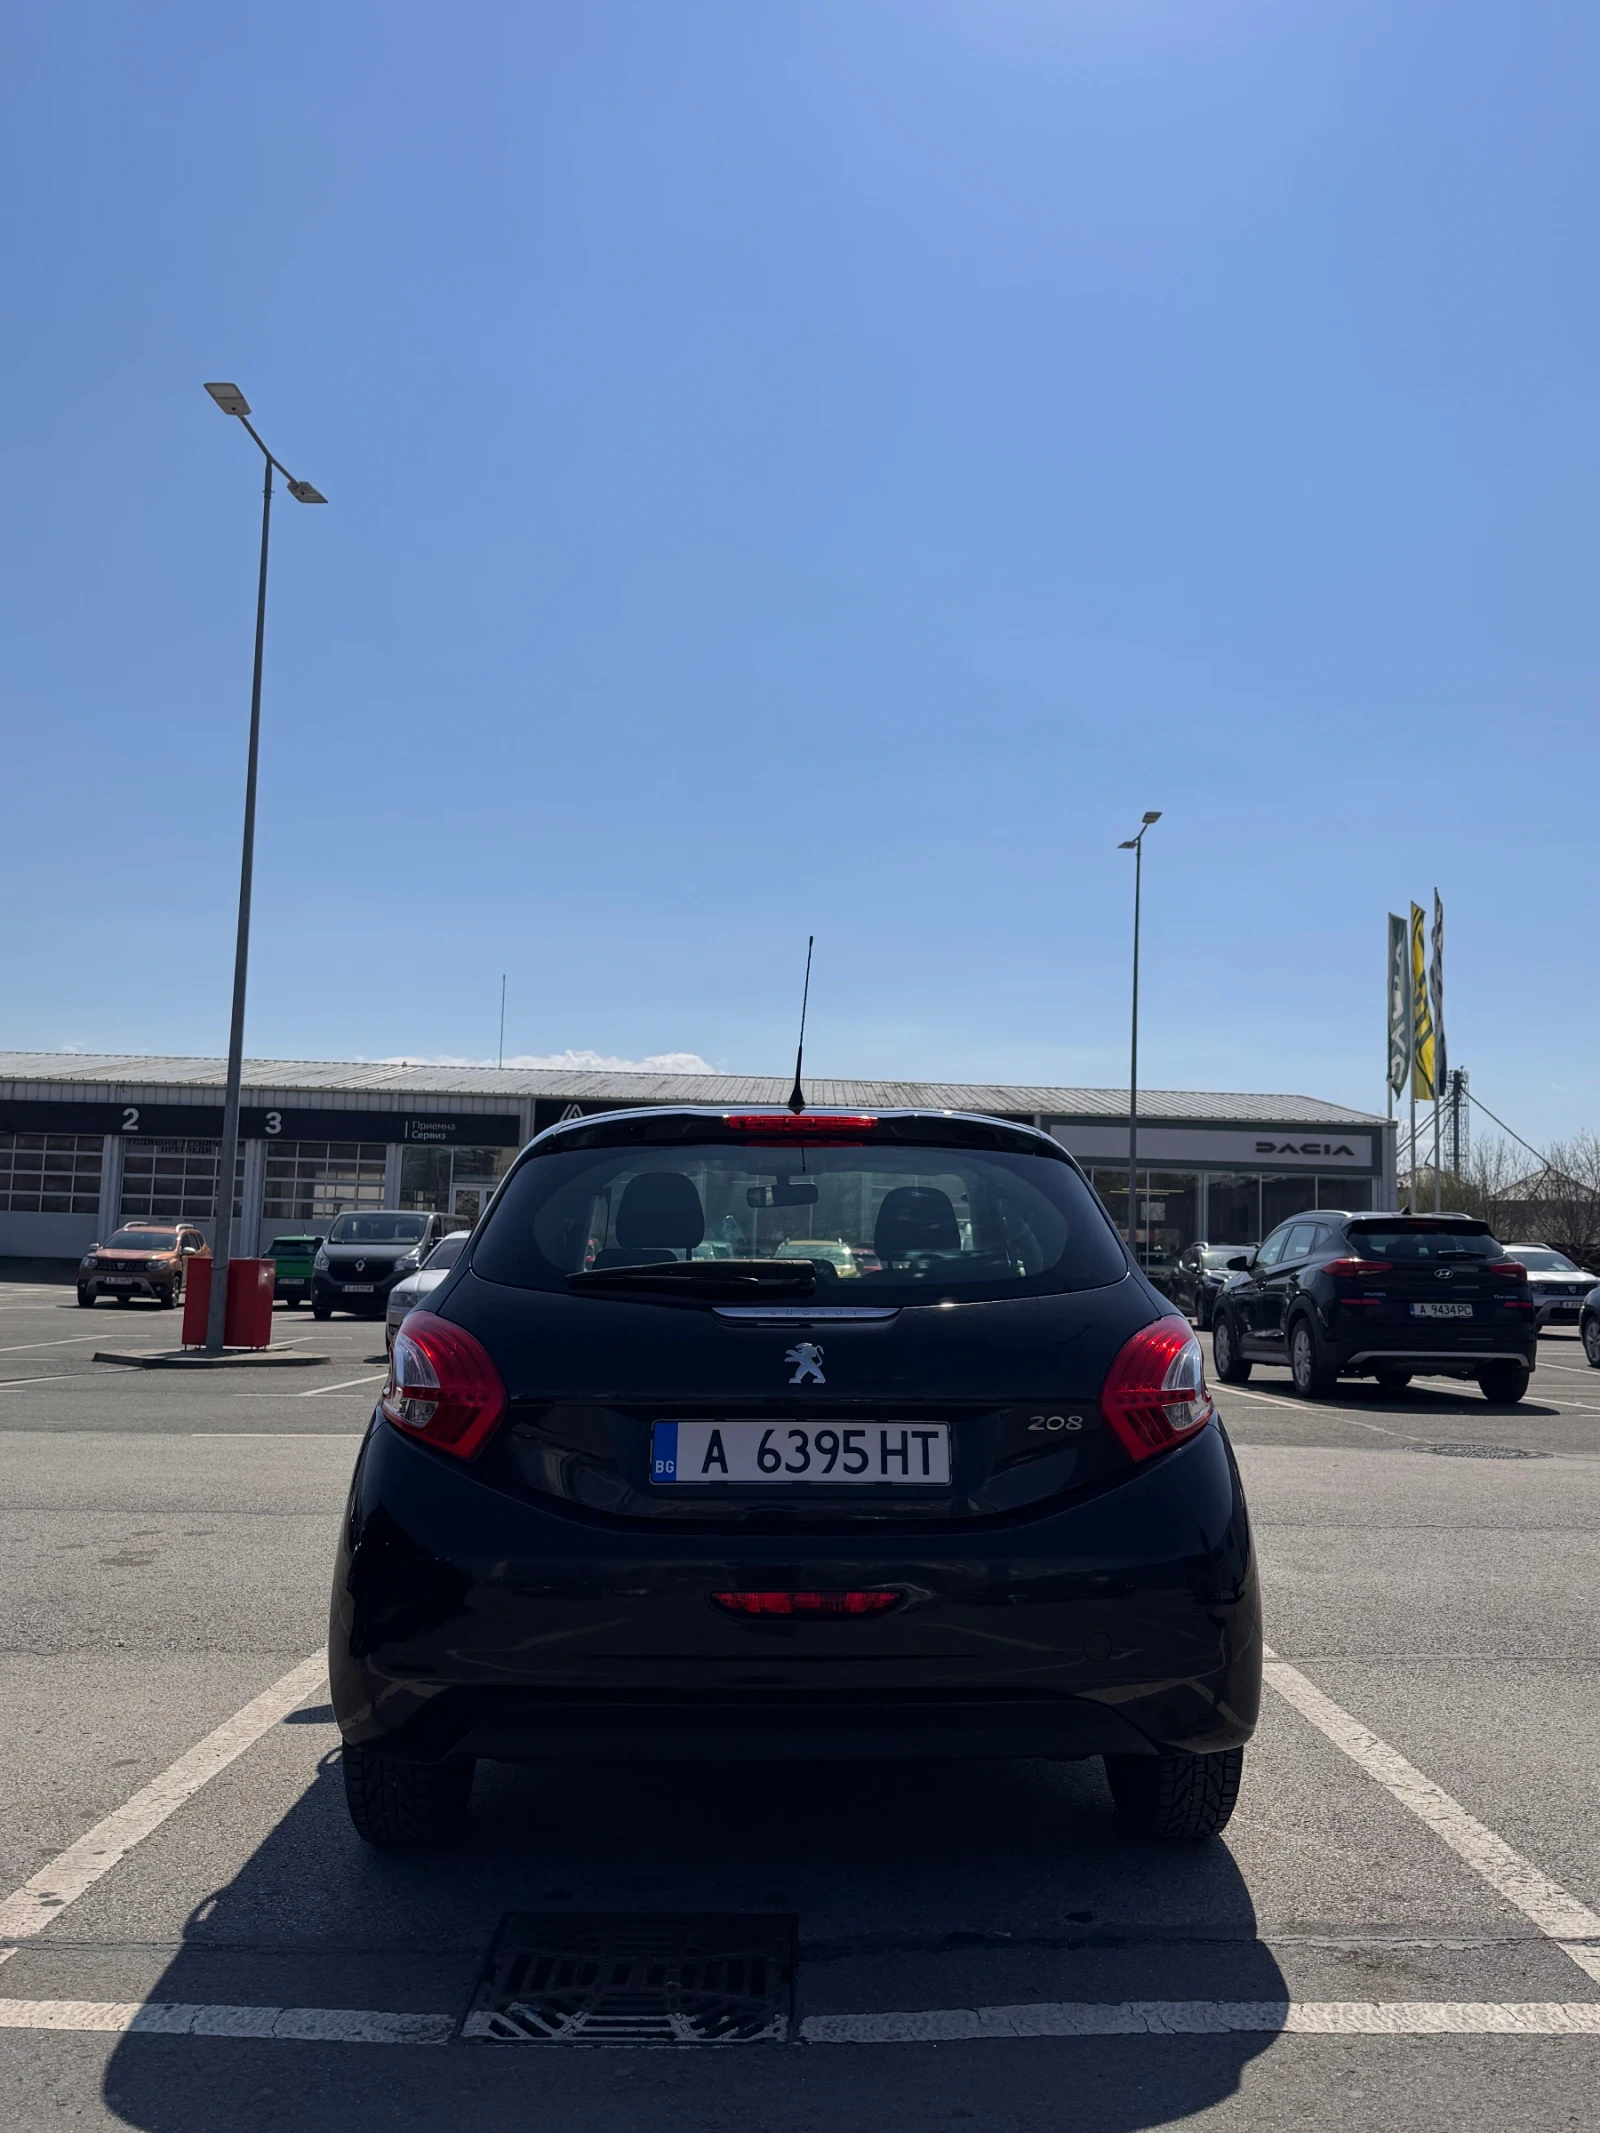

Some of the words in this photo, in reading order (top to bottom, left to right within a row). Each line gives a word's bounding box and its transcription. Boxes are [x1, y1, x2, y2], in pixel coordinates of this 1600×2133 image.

[122, 1108, 140, 1131] 2
[264, 1112, 282, 1134] 3
[412, 1120, 456, 1131] Приемна
[411, 1130, 447, 1141] Сервиз
[1255, 1141, 1356, 1157] DACIA
[1420, 1304, 1427, 1315] A
[1027, 1415, 1083, 1431] 208
[655, 1460, 675, 1474] BG
[701, 1429, 729, 1474] A
